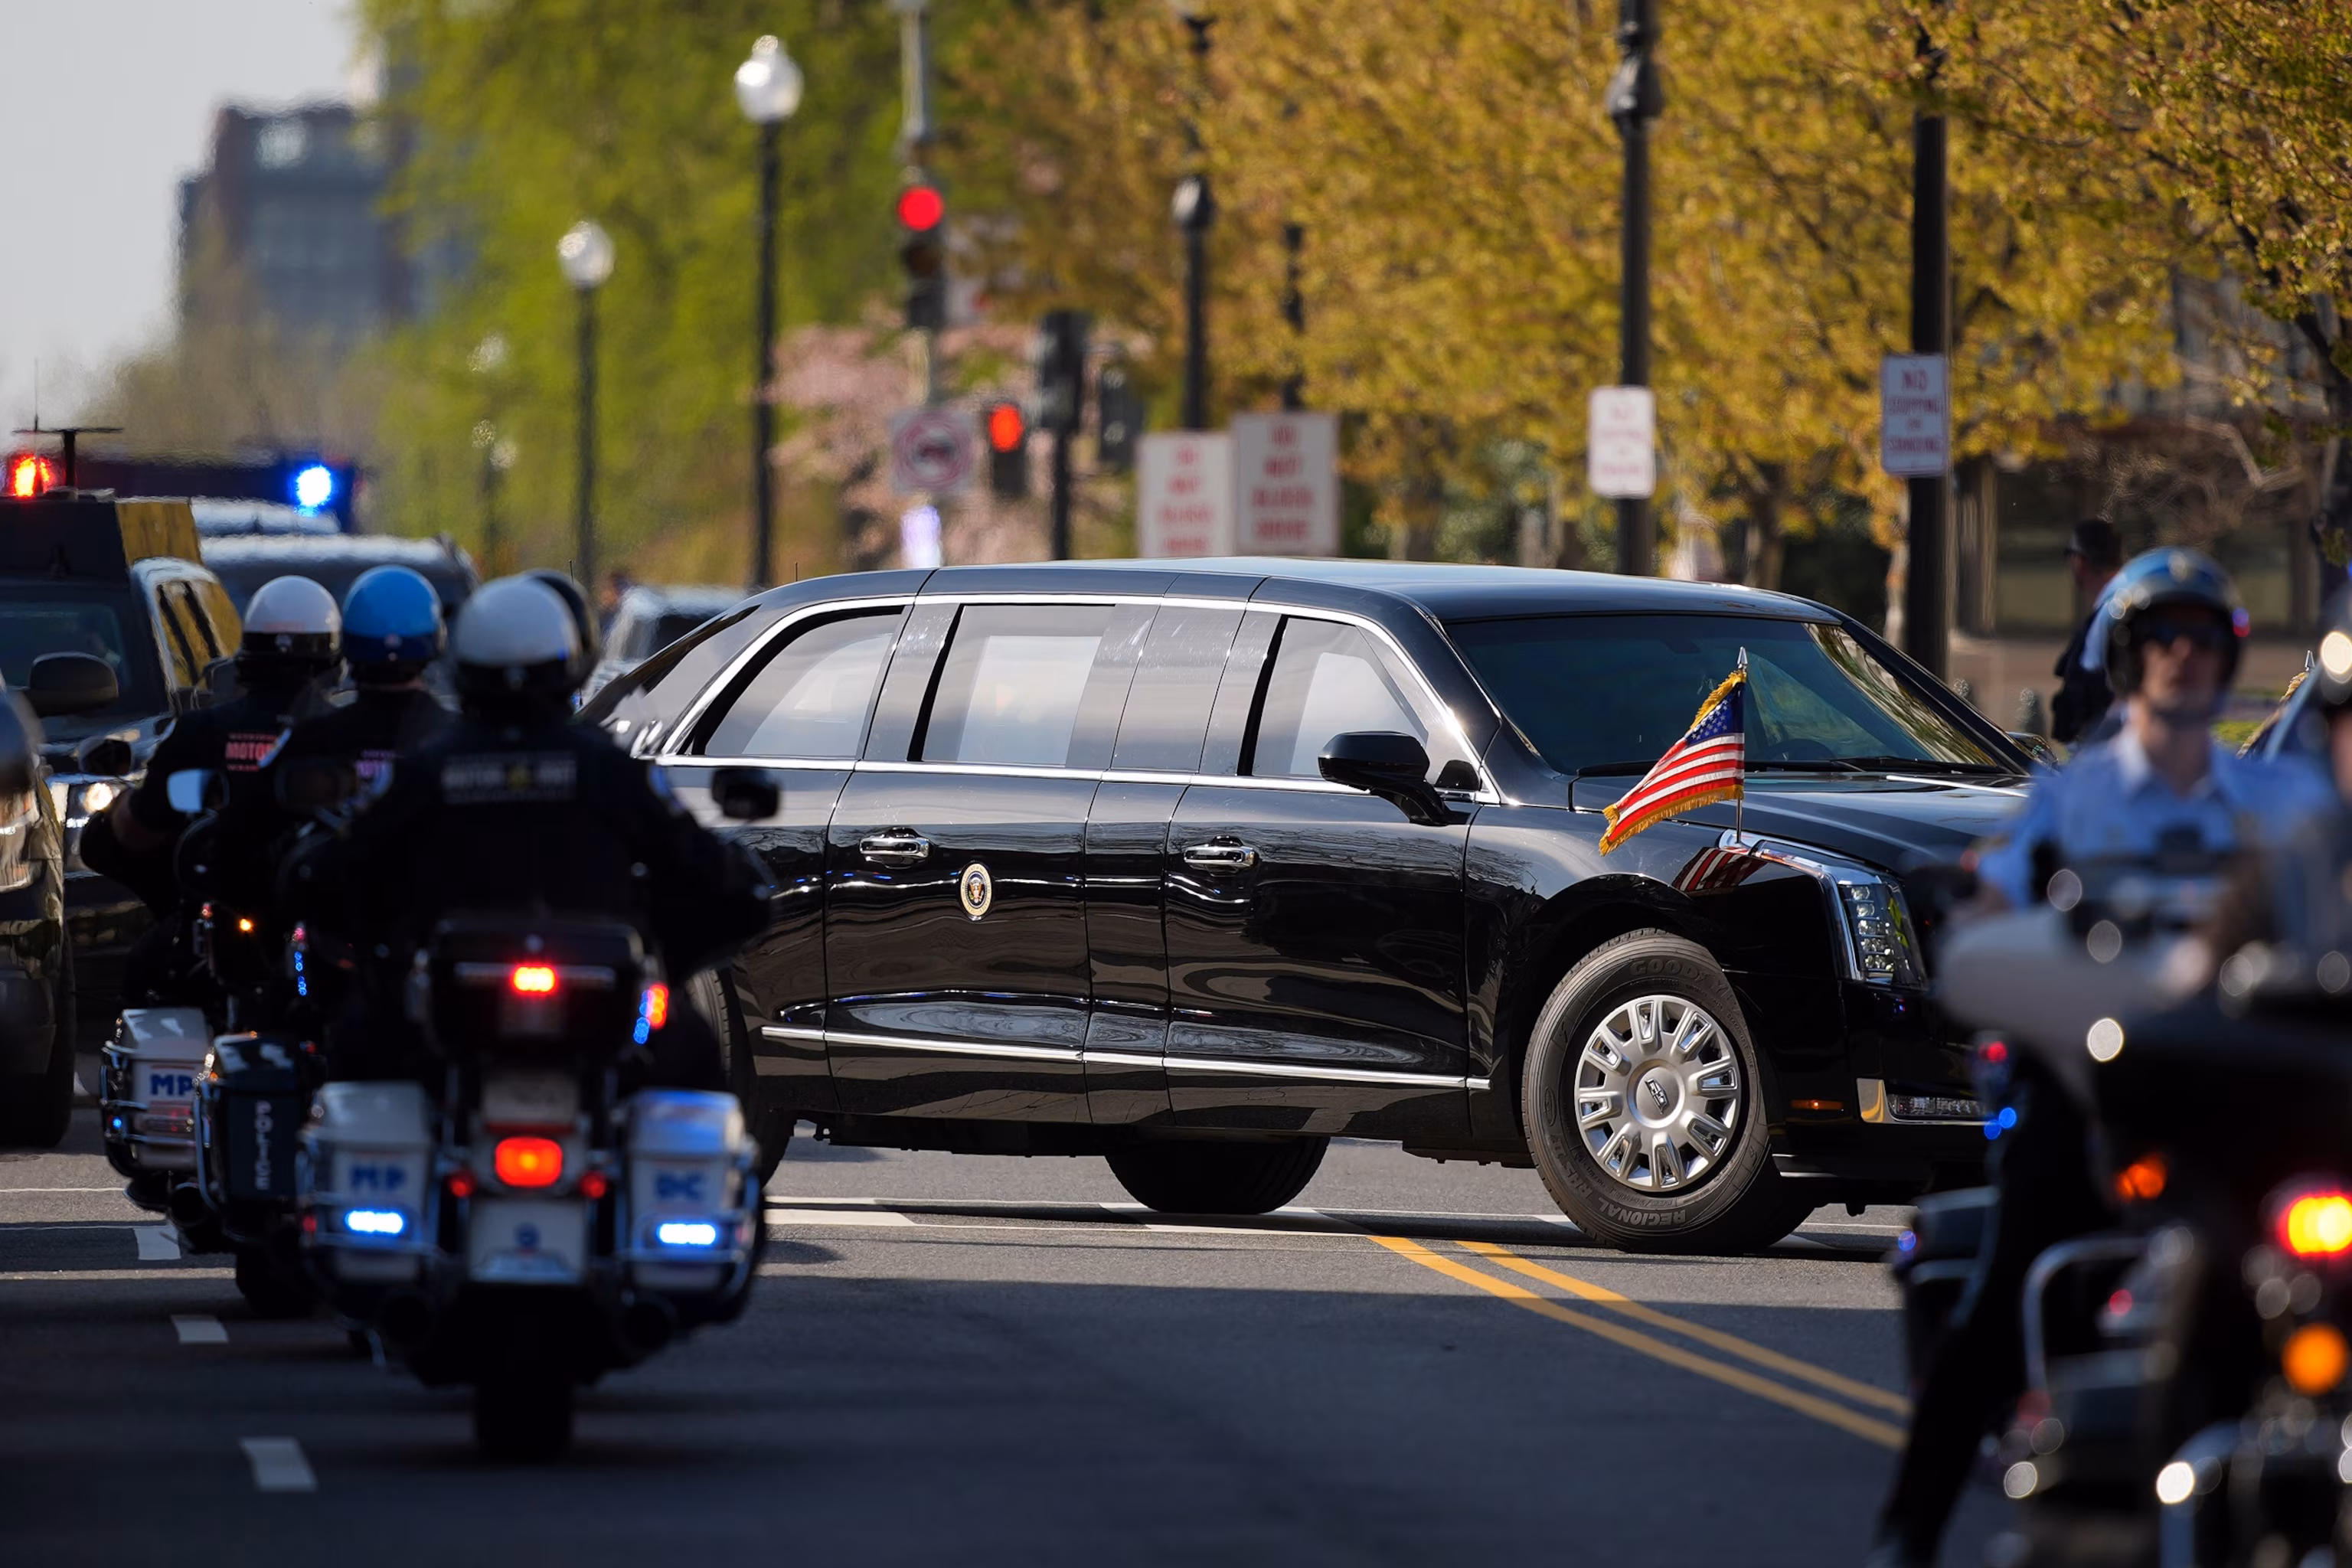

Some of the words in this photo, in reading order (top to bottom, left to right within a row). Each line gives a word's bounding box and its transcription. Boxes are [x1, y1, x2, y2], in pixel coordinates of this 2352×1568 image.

[1902, 369, 1929, 393] NO
[150, 1073, 194, 1096] MP
[255, 1100, 273, 1190] POLICE
[349, 1164, 407, 1190] MP
[1598, 1196, 1687, 1226] REGIONAL
